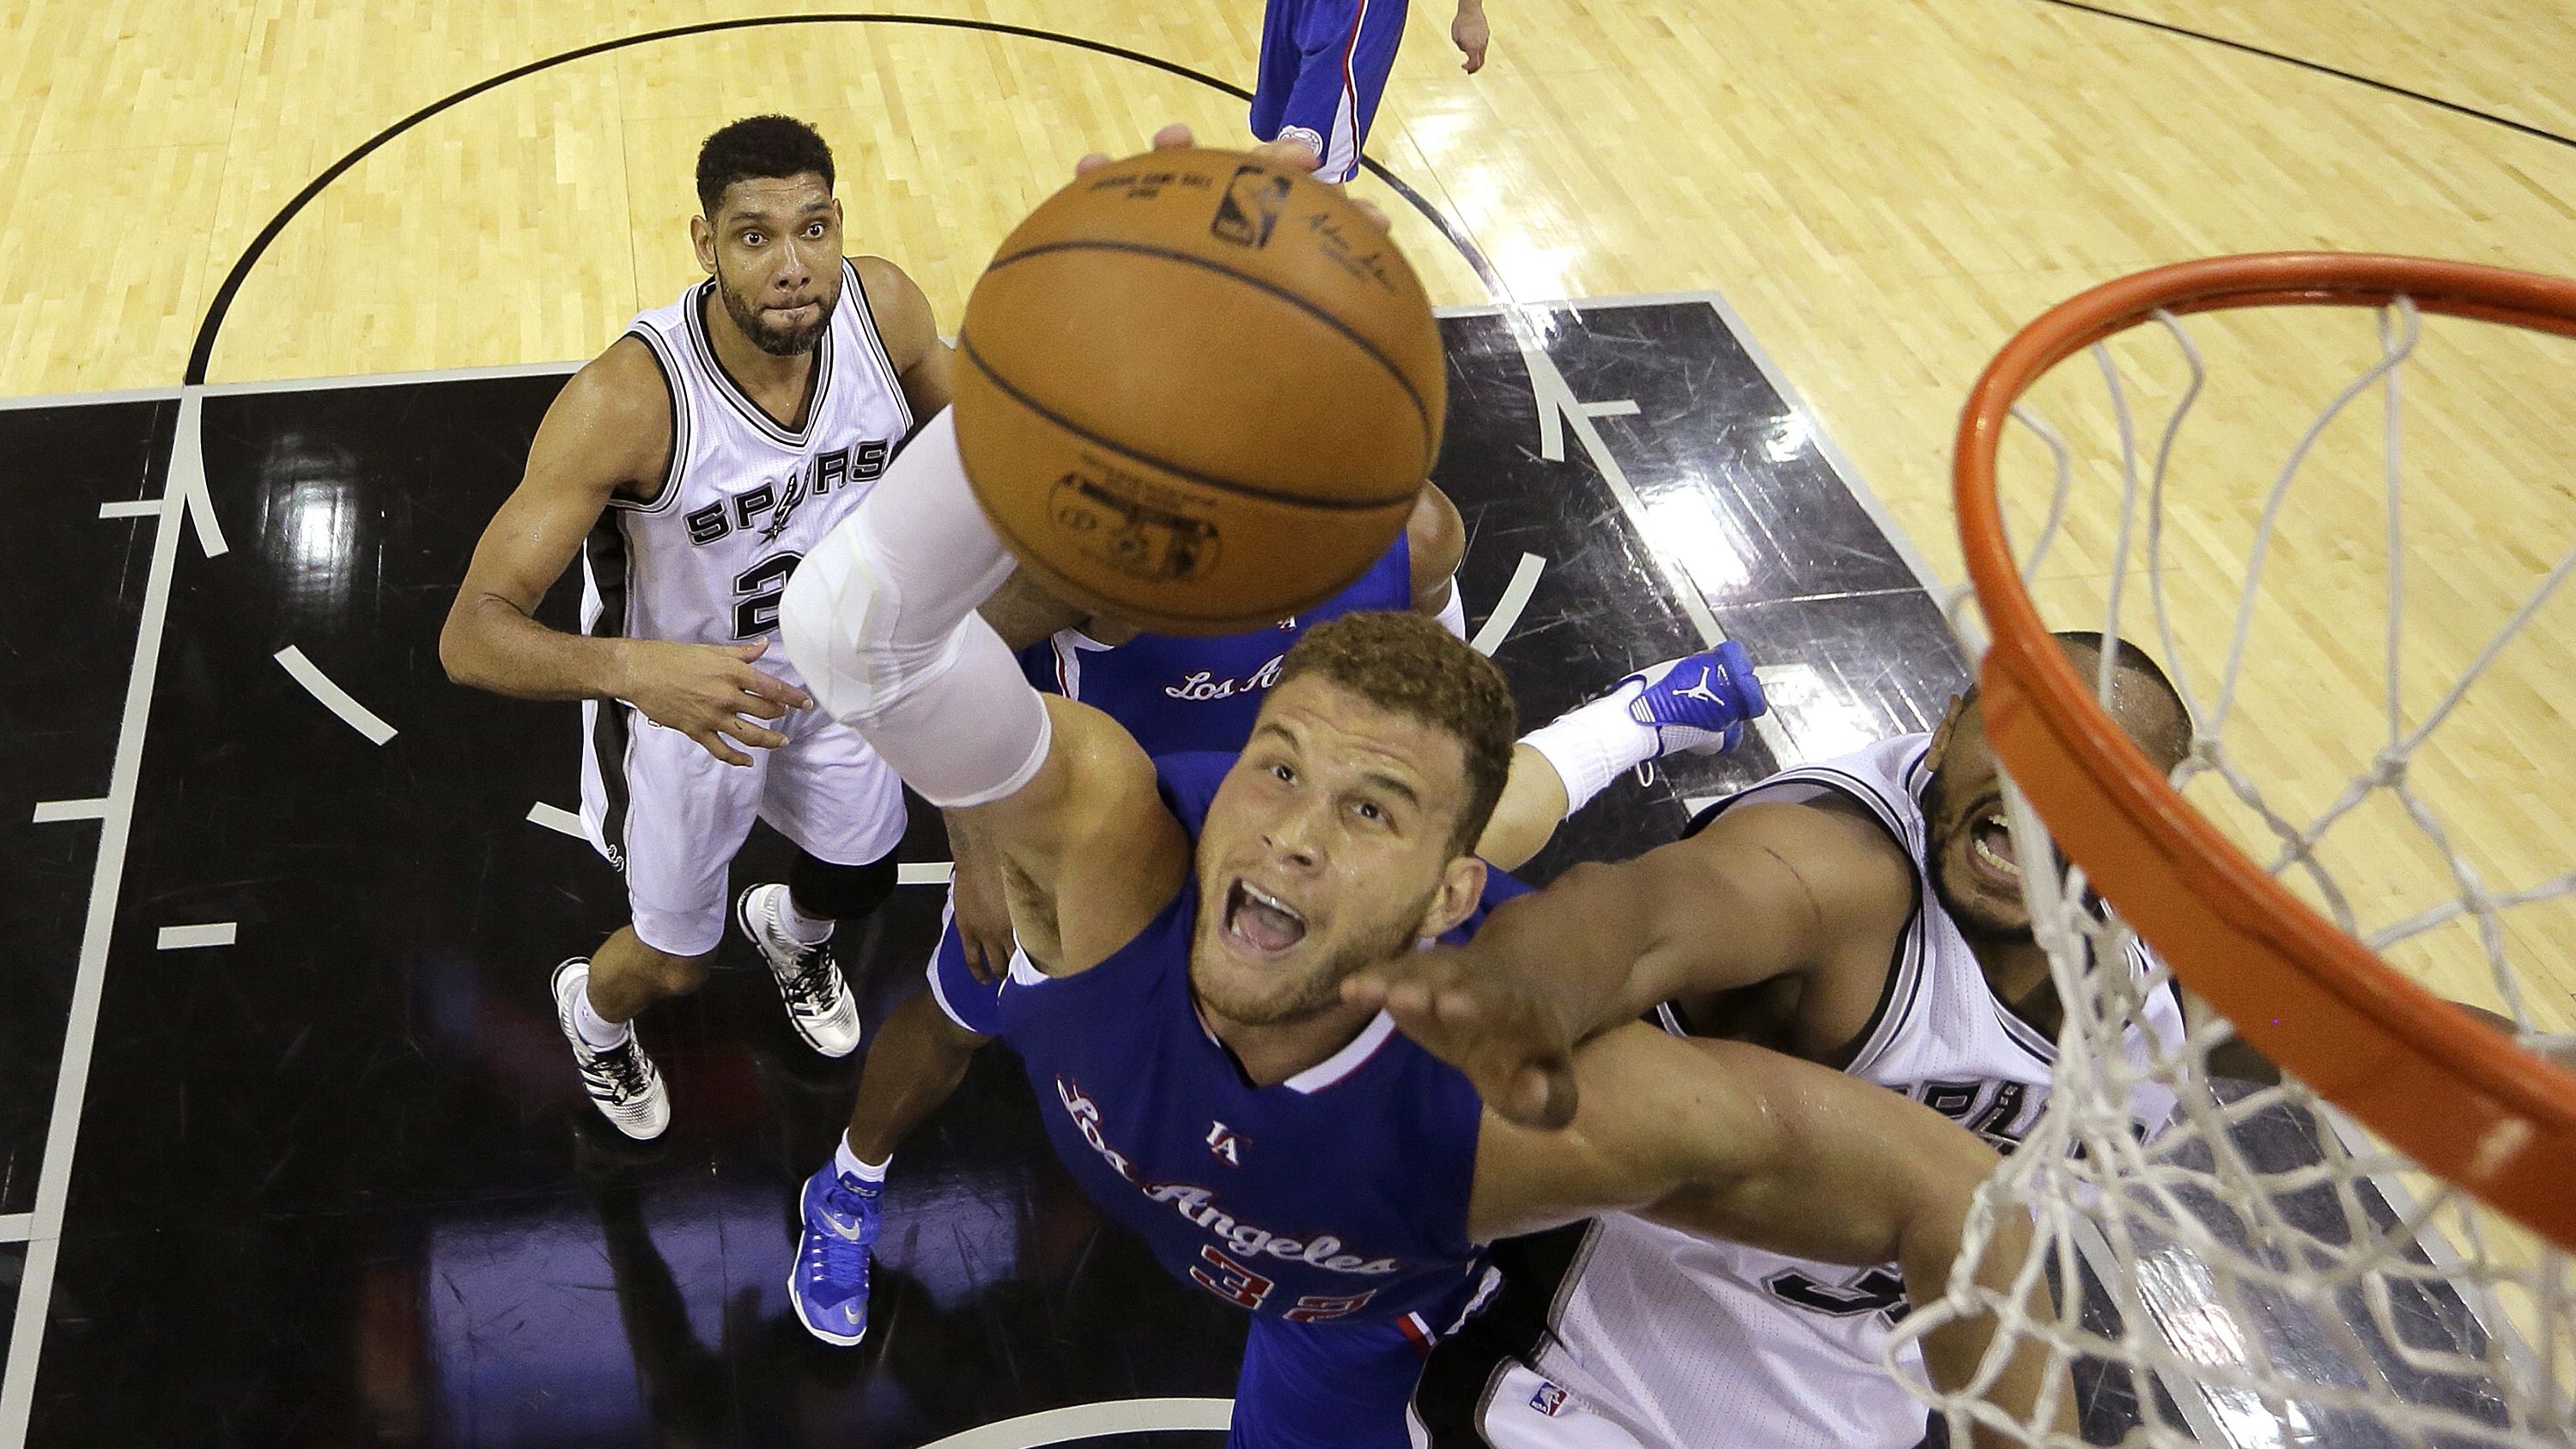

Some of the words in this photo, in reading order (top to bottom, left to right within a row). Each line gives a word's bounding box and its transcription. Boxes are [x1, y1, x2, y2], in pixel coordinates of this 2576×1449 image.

[683, 438, 888, 547] SPURS
[1164, 663, 1236, 700] Los
[1055, 1075, 1135, 1184] Los
[1142, 1184, 1400, 1275] Angeles
[1188, 1244, 1378, 1323] 32
